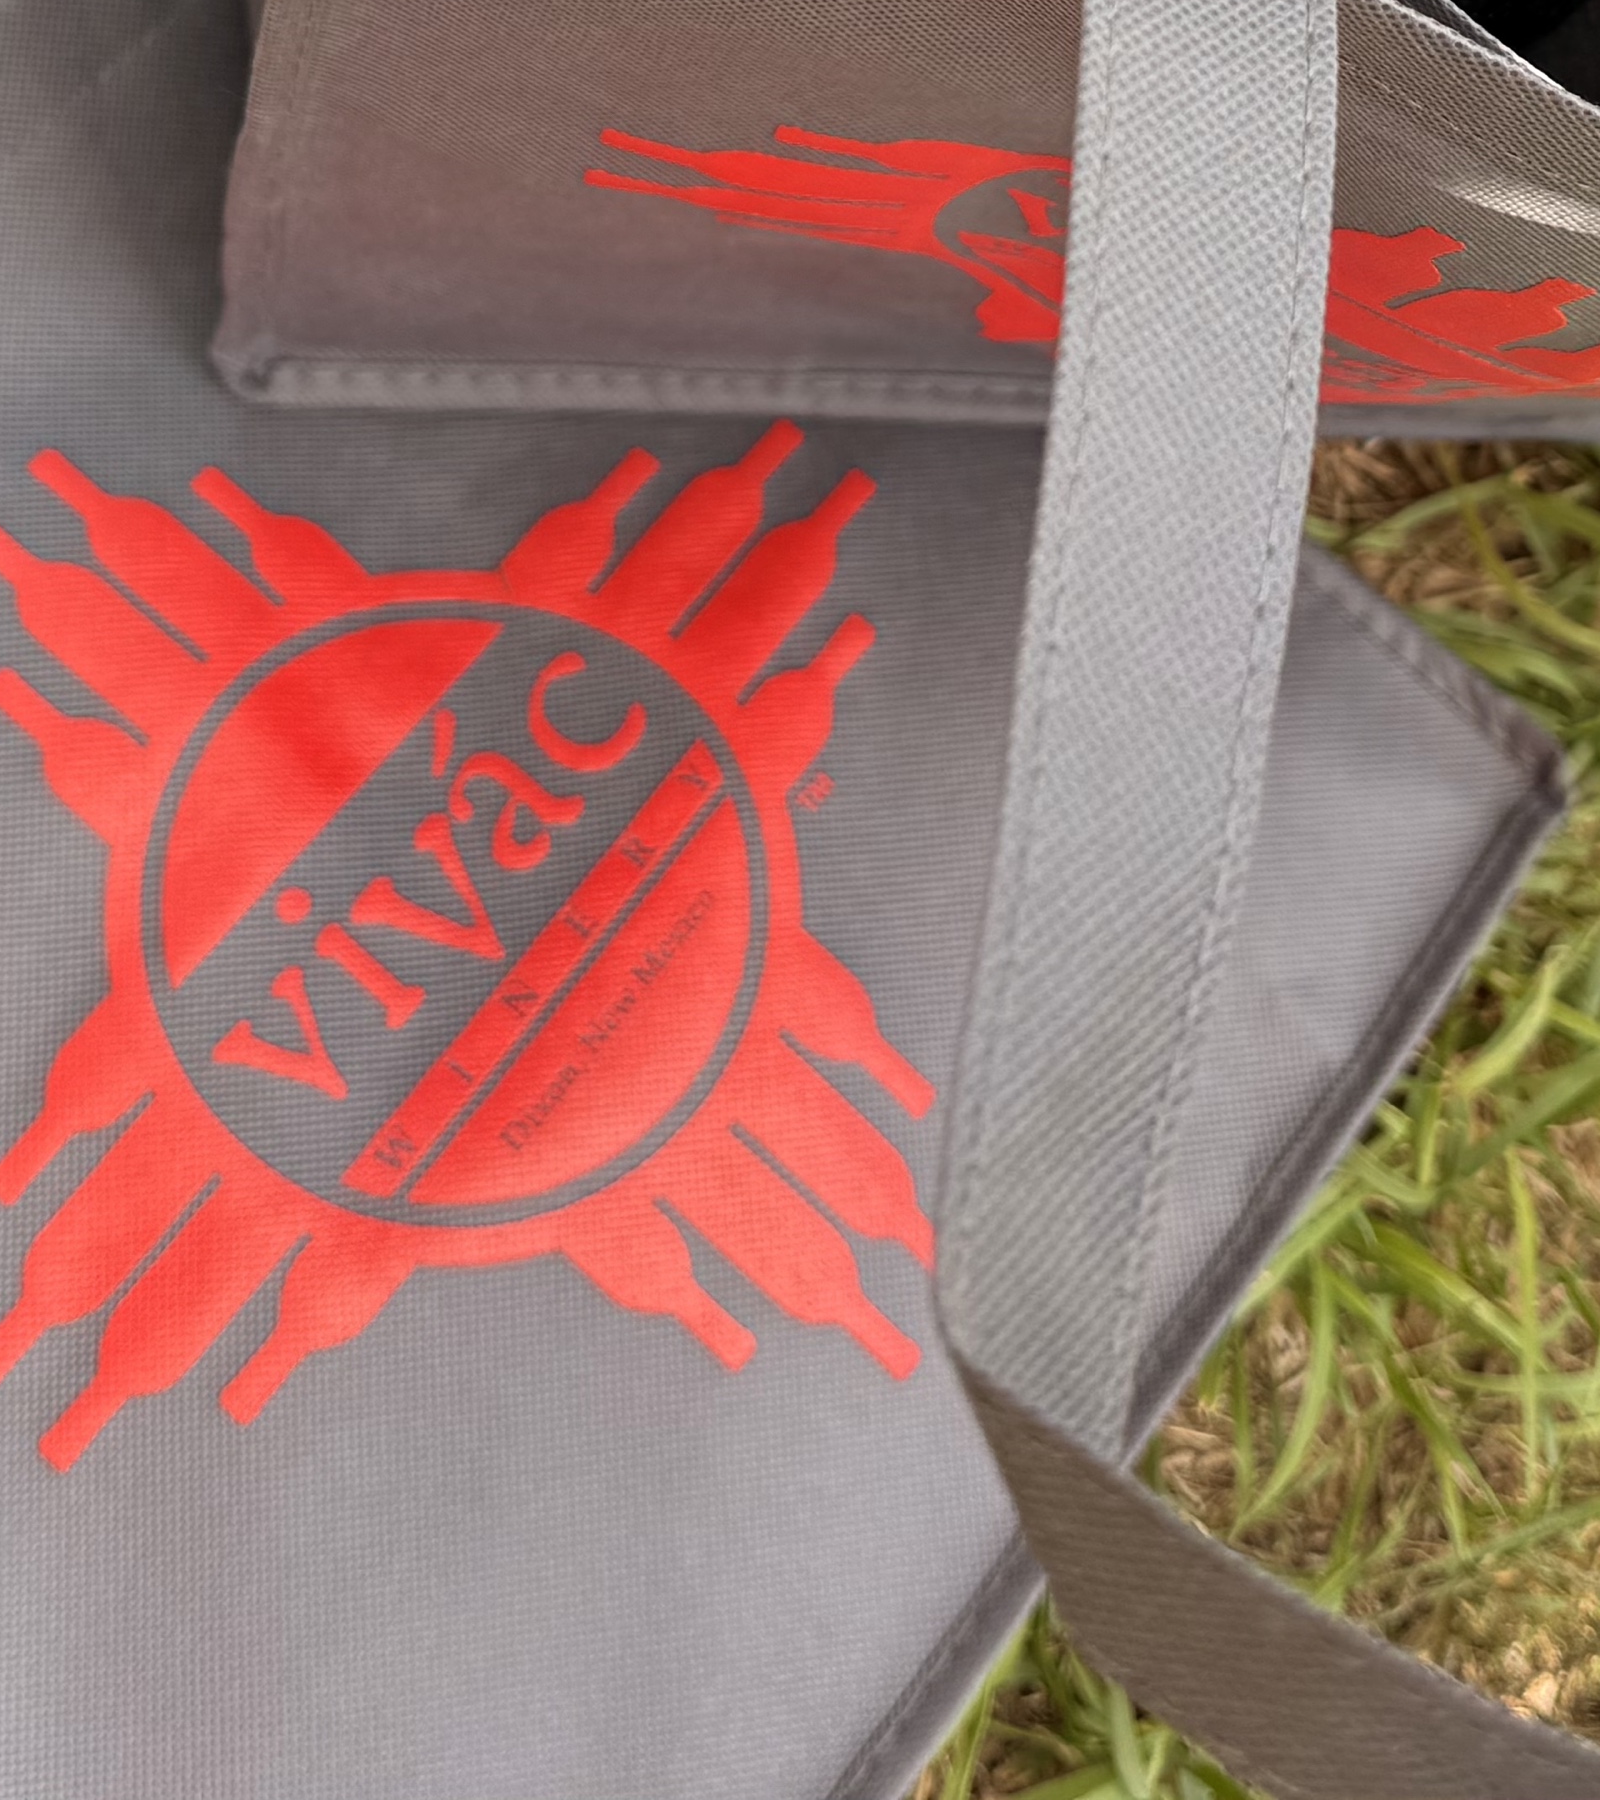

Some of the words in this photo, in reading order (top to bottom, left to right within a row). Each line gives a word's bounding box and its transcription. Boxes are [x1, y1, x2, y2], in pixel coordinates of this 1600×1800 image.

[212, 651, 647, 1099] vivác
[578, 986, 637, 1052] New
[629, 889, 715, 985] Mexico
